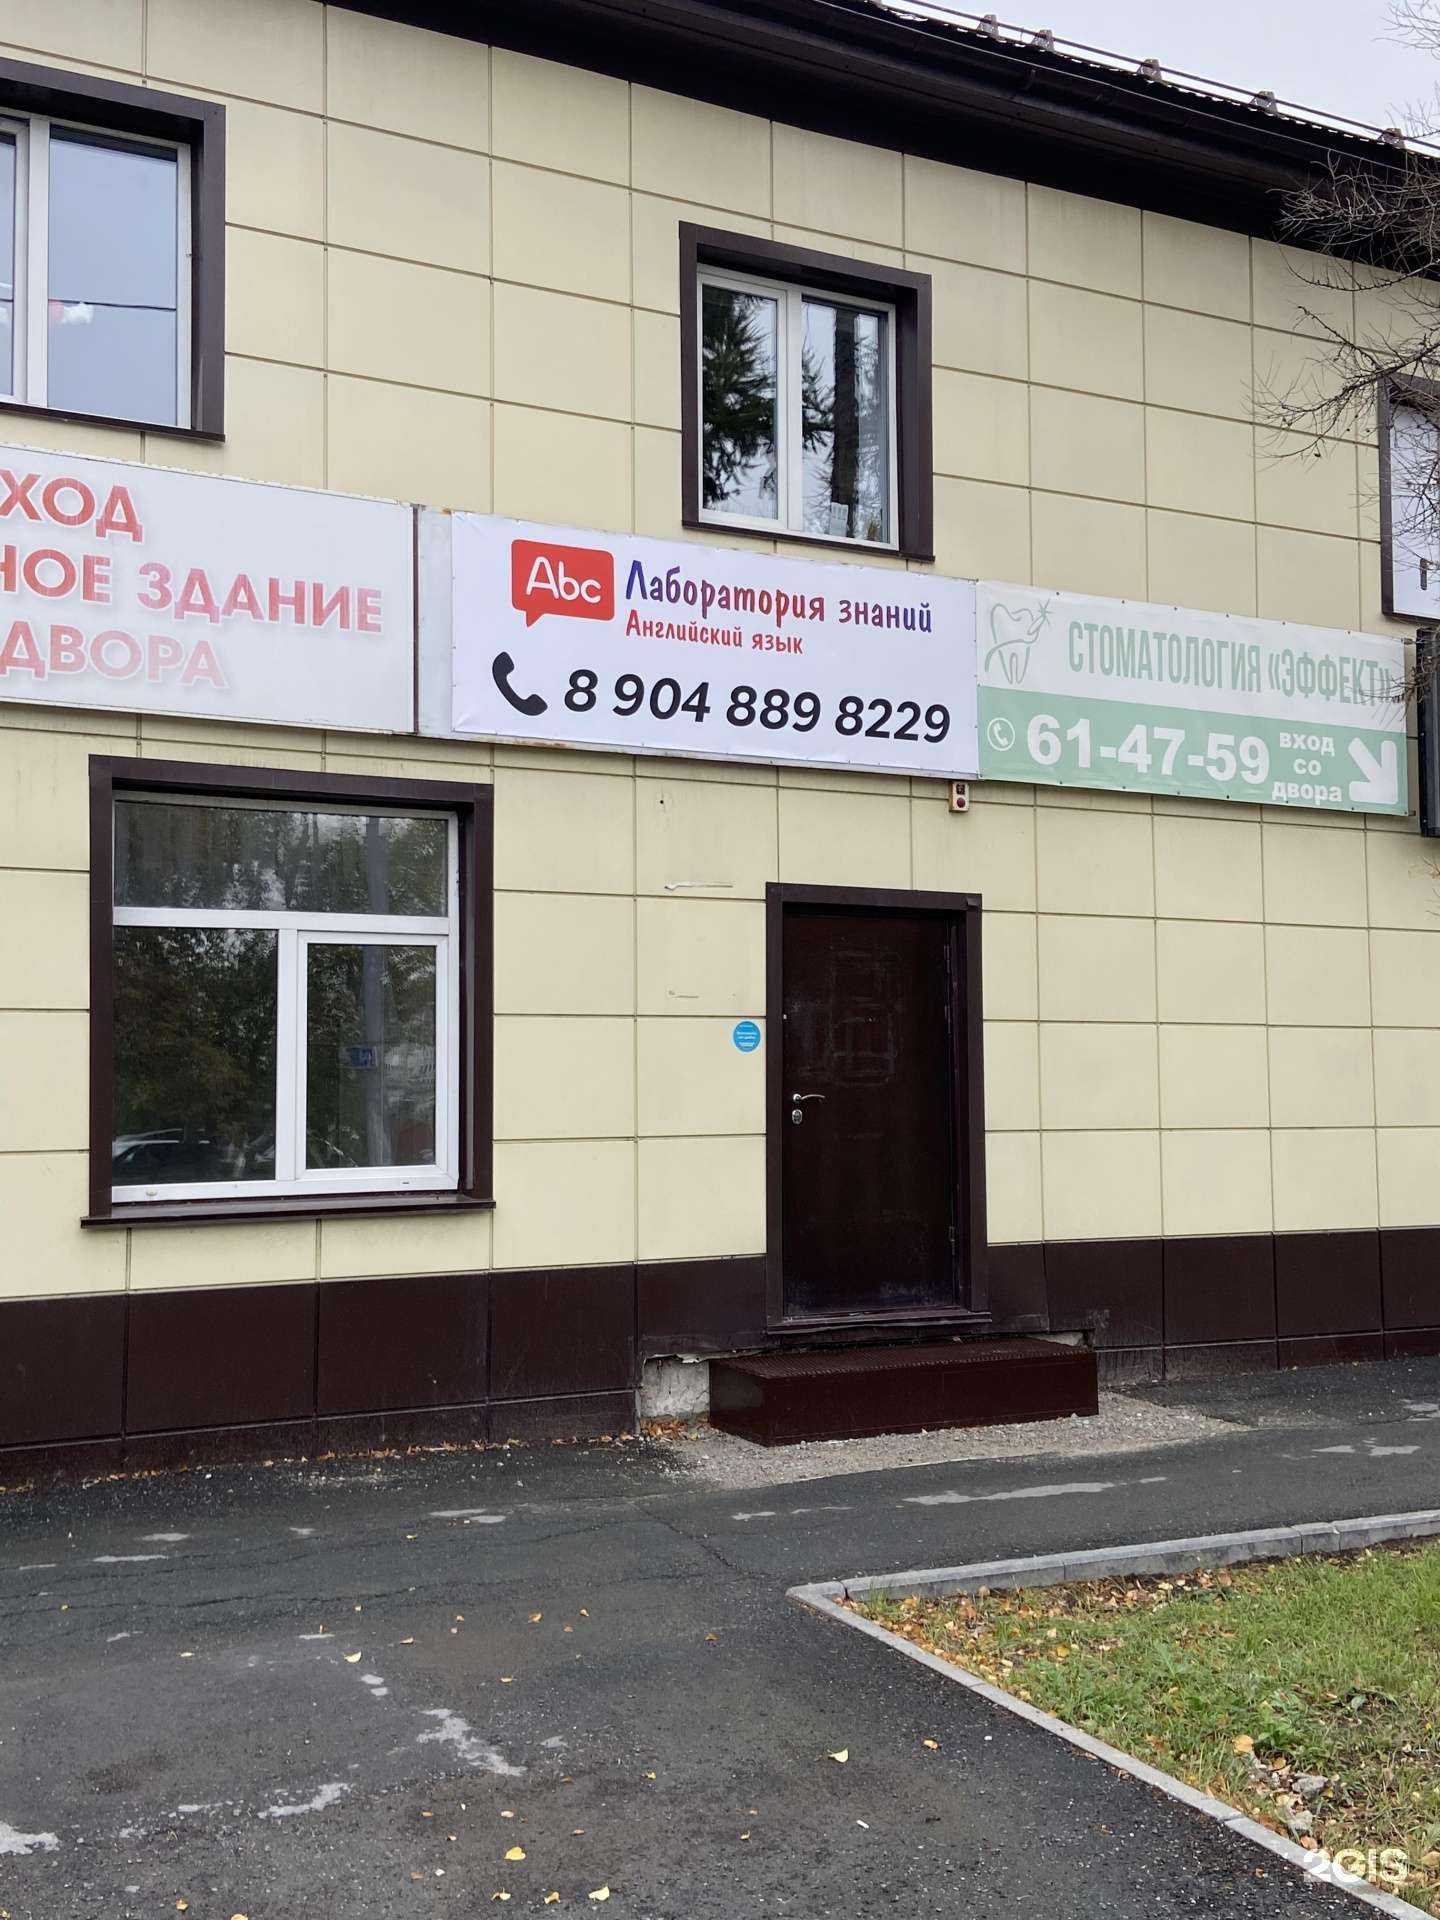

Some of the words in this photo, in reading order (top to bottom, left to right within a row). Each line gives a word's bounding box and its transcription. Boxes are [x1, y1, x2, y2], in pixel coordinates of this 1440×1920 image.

[136, 561, 382, 633] ЗДАНИЕ
[525, 556, 602, 604] Abc
[626, 560, 826, 627] Лаборатория
[839, 599, 933, 633] знаний
[0, 620, 227, 688] ДВОРА
[626, 609, 744, 649] Английский
[752, 633, 804, 655] язык
[1068, 620, 1262, 694] СТОМАТОЛОГИЯ
[564, 669, 598, 712] 8
[613, 673, 711, 723] 904
[726, 685, 822, 732] 889
[835, 696, 951, 744] 8229
[1027, 713, 1270, 785] 61-47-59
[1279, 731, 1336, 757] вход
[1293, 758, 1323, 776] со
[1272, 780, 1342, 805] двора
